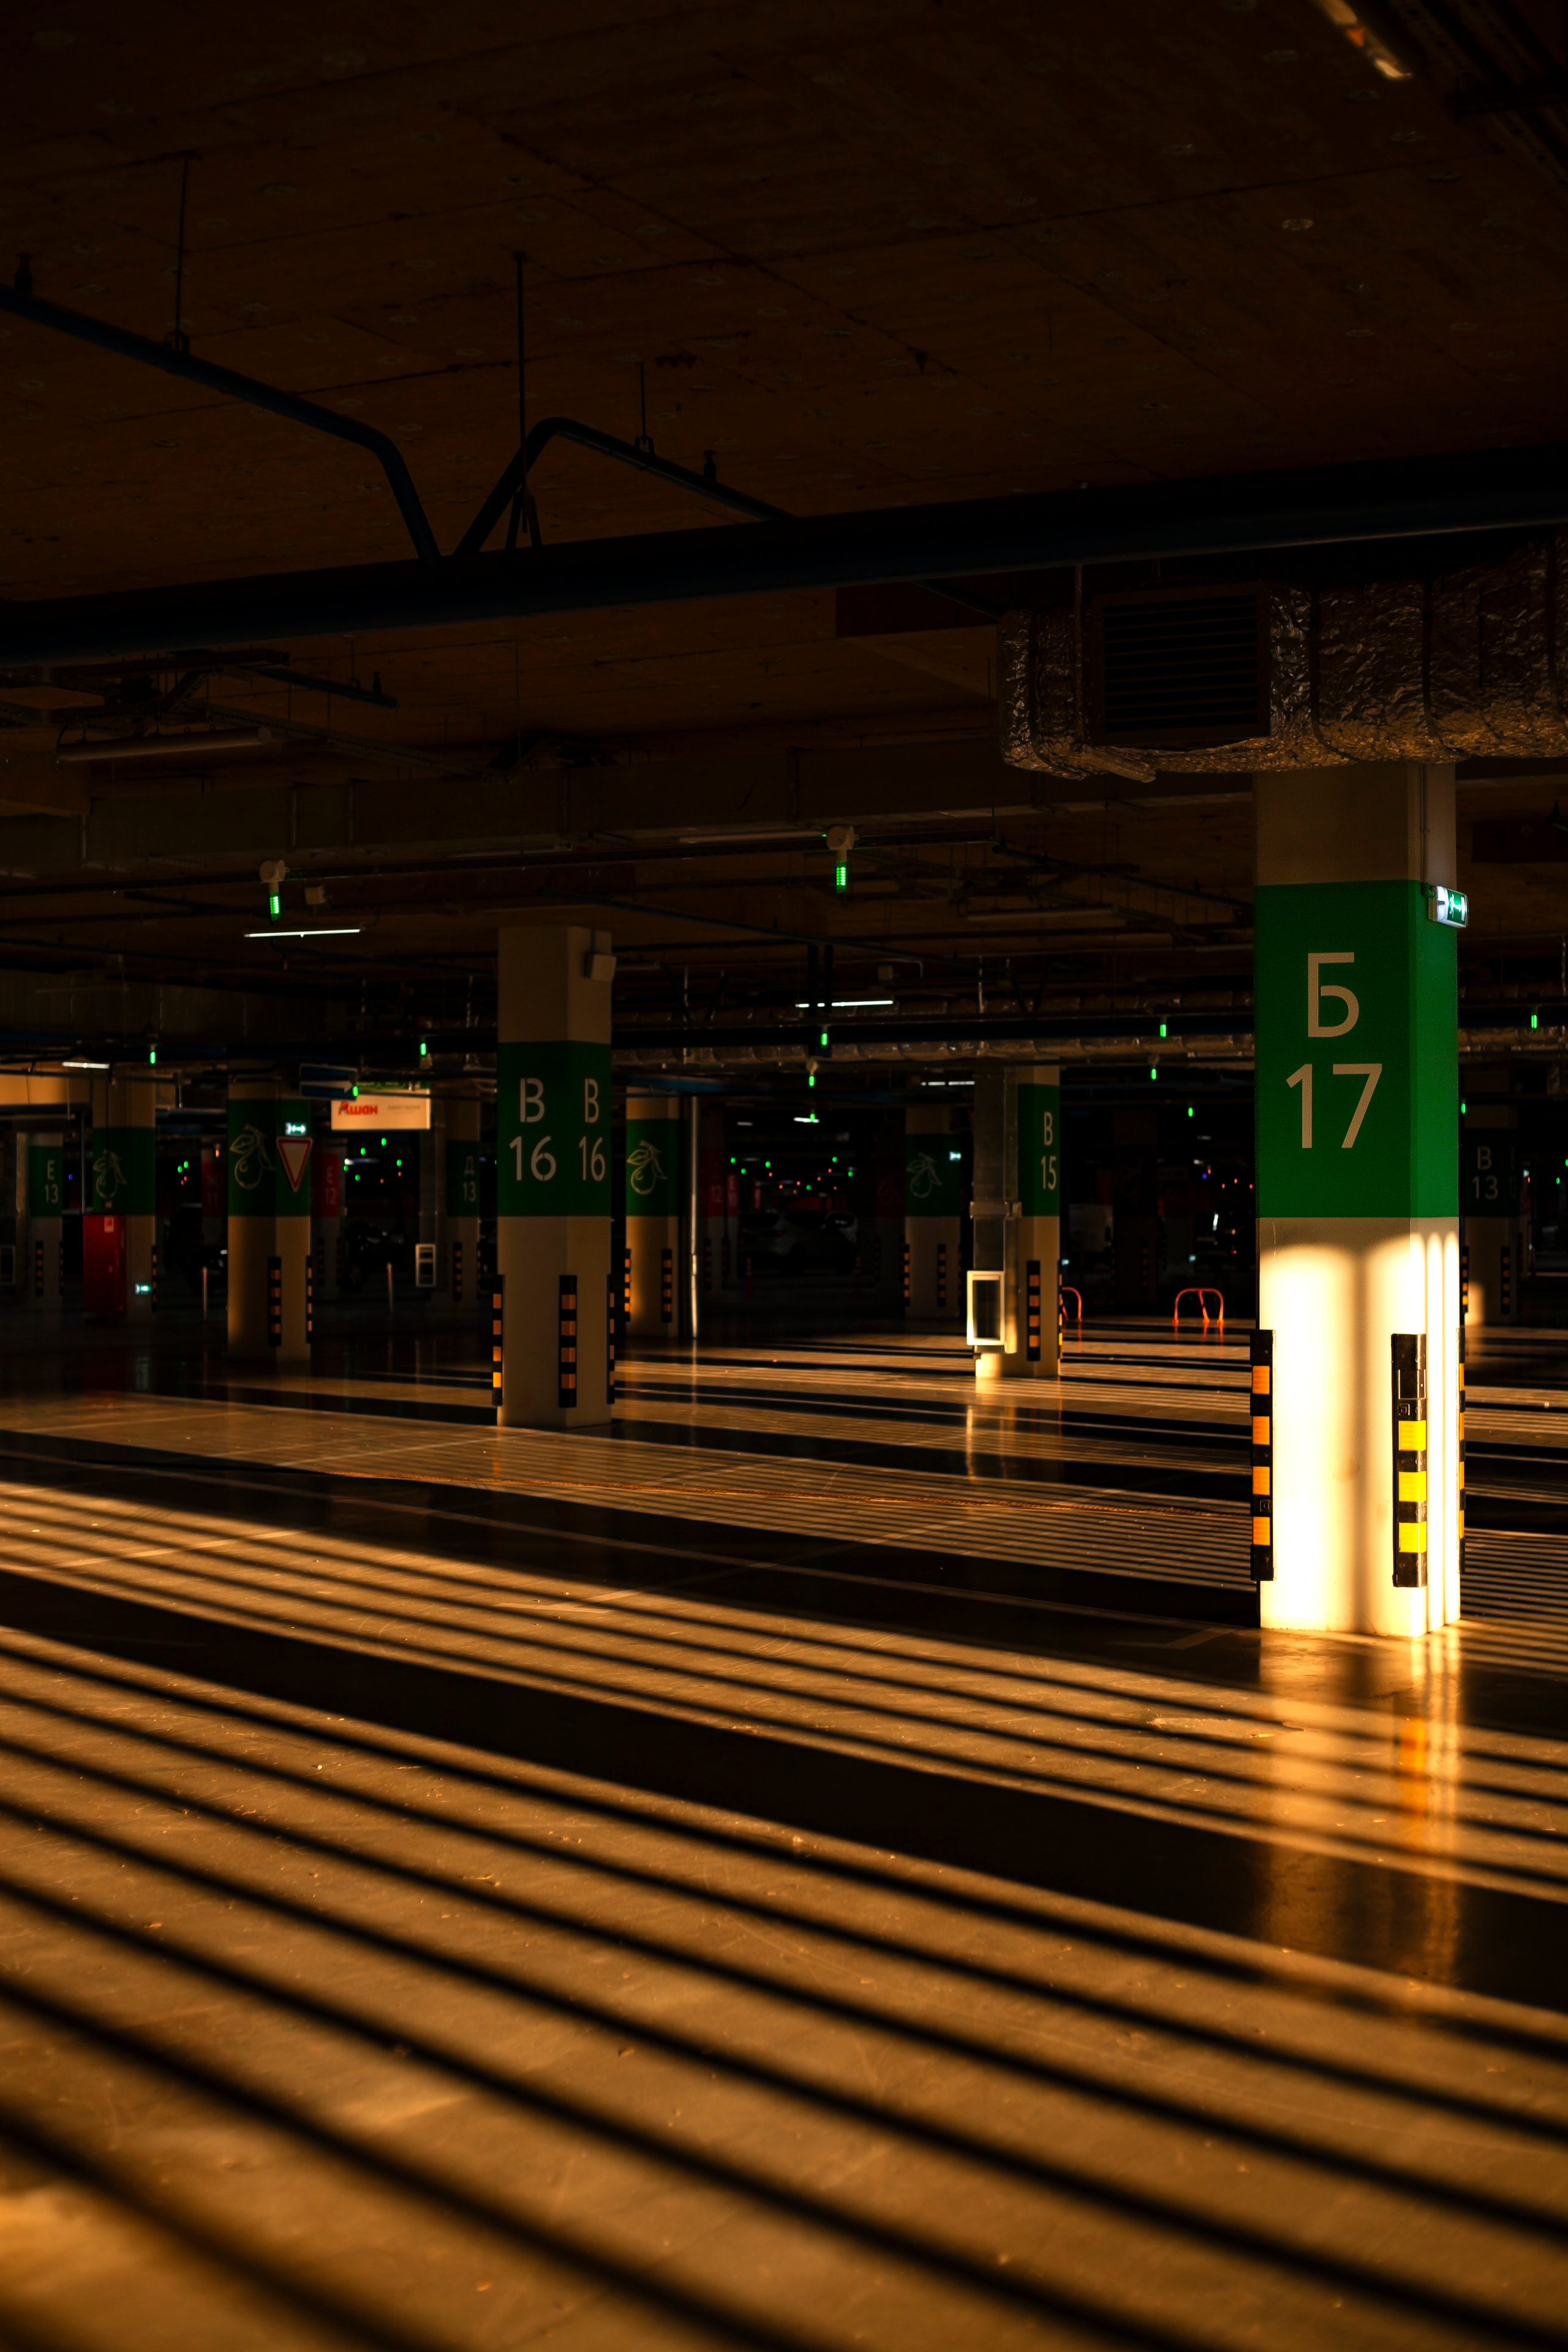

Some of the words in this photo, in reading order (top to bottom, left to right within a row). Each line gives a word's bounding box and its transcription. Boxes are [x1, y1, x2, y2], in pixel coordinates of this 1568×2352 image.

[1308, 952, 1360, 1038] Б
[520, 1078, 545, 1123] В
[584, 1078, 599, 1123] В
[1286, 1063, 1382, 1148] 17
[1043, 1111, 1054, 1145] В
[509, 1135, 557, 1182] 16
[579, 1136, 605, 1182] 16
[1041, 1155, 1057, 1190] 15
[1477, 1145, 1492, 1170] В
[44, 1183, 59, 1204] 13
[325, 1188, 336, 1205] 12
[462, 1182, 477, 1202] 13
[1472, 1175, 1499, 1200] 13
